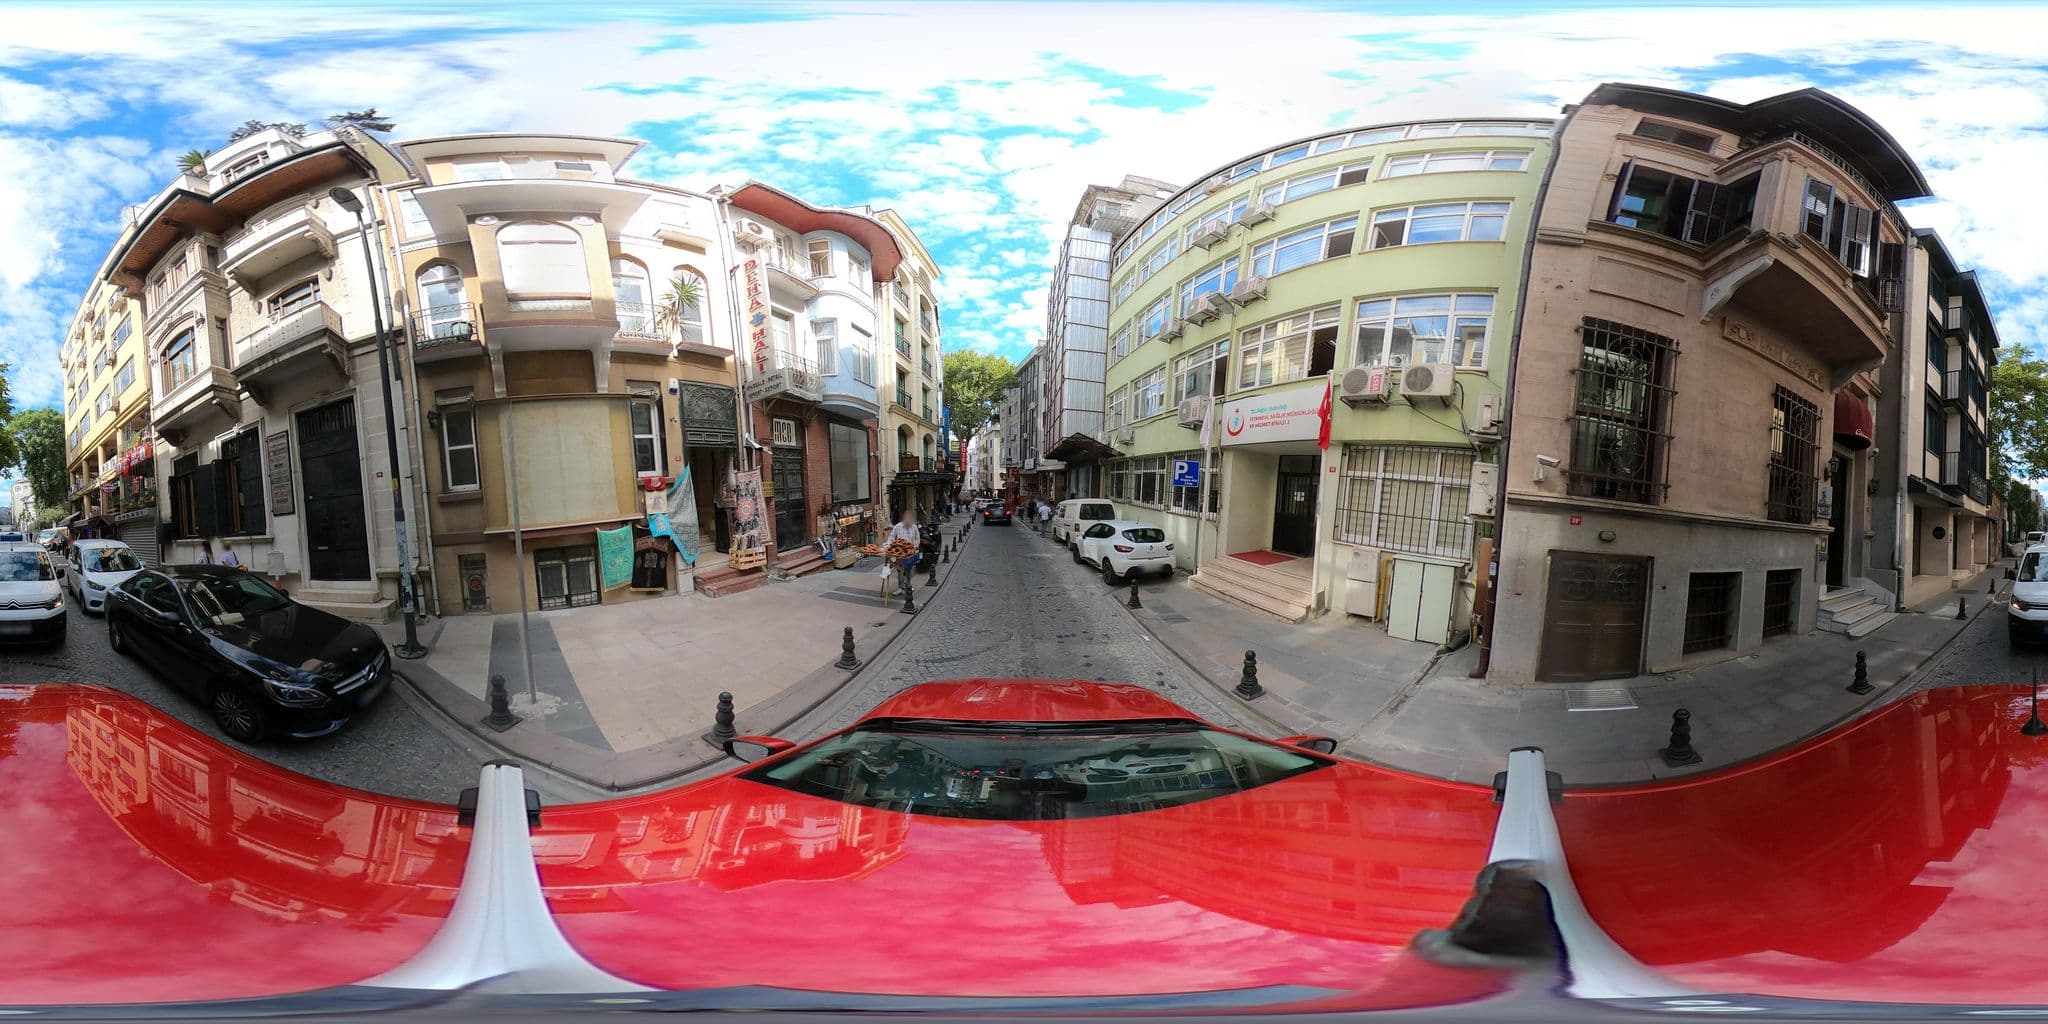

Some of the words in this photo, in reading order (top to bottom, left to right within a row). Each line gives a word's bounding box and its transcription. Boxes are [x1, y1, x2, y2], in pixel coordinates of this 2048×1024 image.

[743, 259, 764, 312] DEHA
[752, 328, 768, 374] HALI
[1270, 411, 1286, 419] SAĞLIK
[1175, 461, 1188, 480] P
